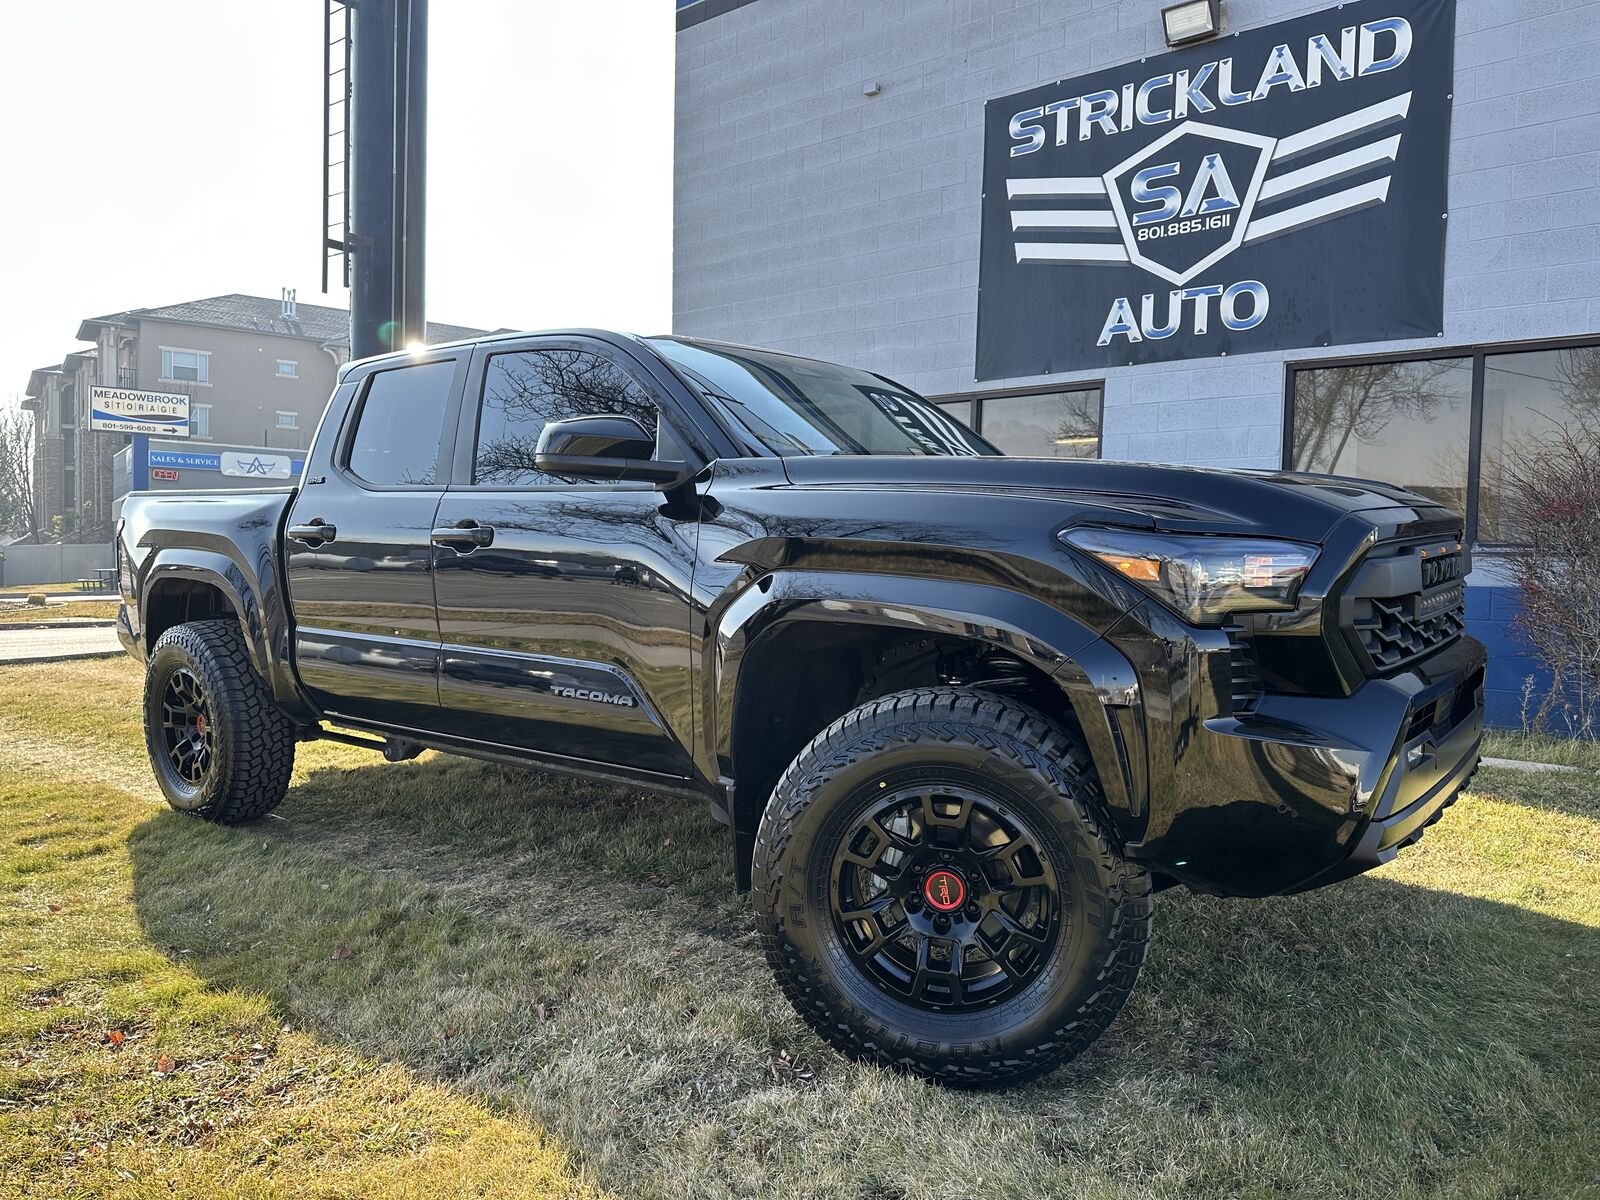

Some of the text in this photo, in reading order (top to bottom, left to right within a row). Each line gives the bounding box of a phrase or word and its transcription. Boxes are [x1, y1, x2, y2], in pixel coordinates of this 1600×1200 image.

[1008, 17, 1413, 157] STRICKLAND
[1130, 153, 1240, 226] SA
[1137, 214, 1231, 241] 801.885.1611
[1096, 280, 1270, 347] AUTO
[93, 390, 187, 405] MEADOWBROOK
[102, 423, 157, 432] 801-599-6083
[151, 455, 176, 464] SALES
[185, 458, 218, 466] SERVICE
[1423, 557, 1462, 585] TOYOTA
[550, 685, 634, 707] TACOMA
[938, 875, 951, 905] TRD
